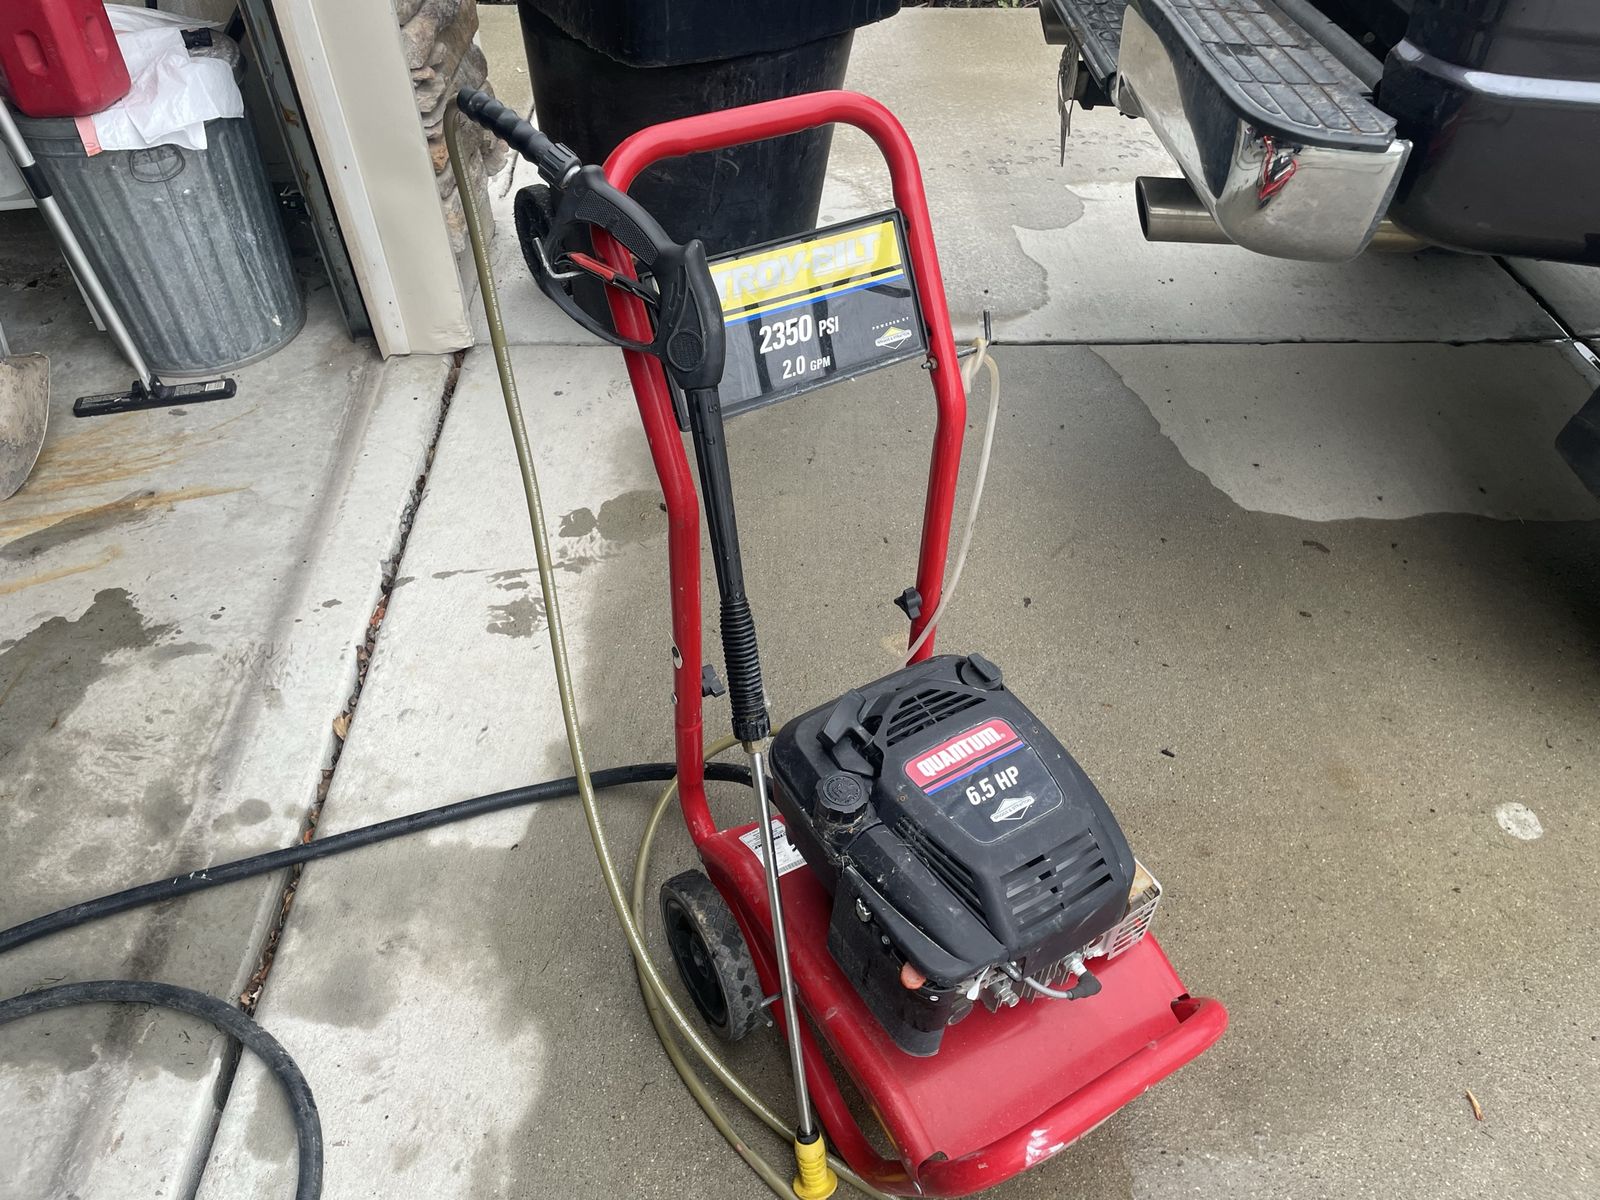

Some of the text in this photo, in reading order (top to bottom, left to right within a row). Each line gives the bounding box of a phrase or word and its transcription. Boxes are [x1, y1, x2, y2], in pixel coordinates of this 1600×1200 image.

[711, 232, 880, 301] TROY-BILT
[759, 315, 839, 354] 2350 PSI
[782, 355, 831, 379] 2.0 GPM
[916, 727, 1002, 777] QUANTUM
[966, 766, 1019, 805] 6.5 HP
